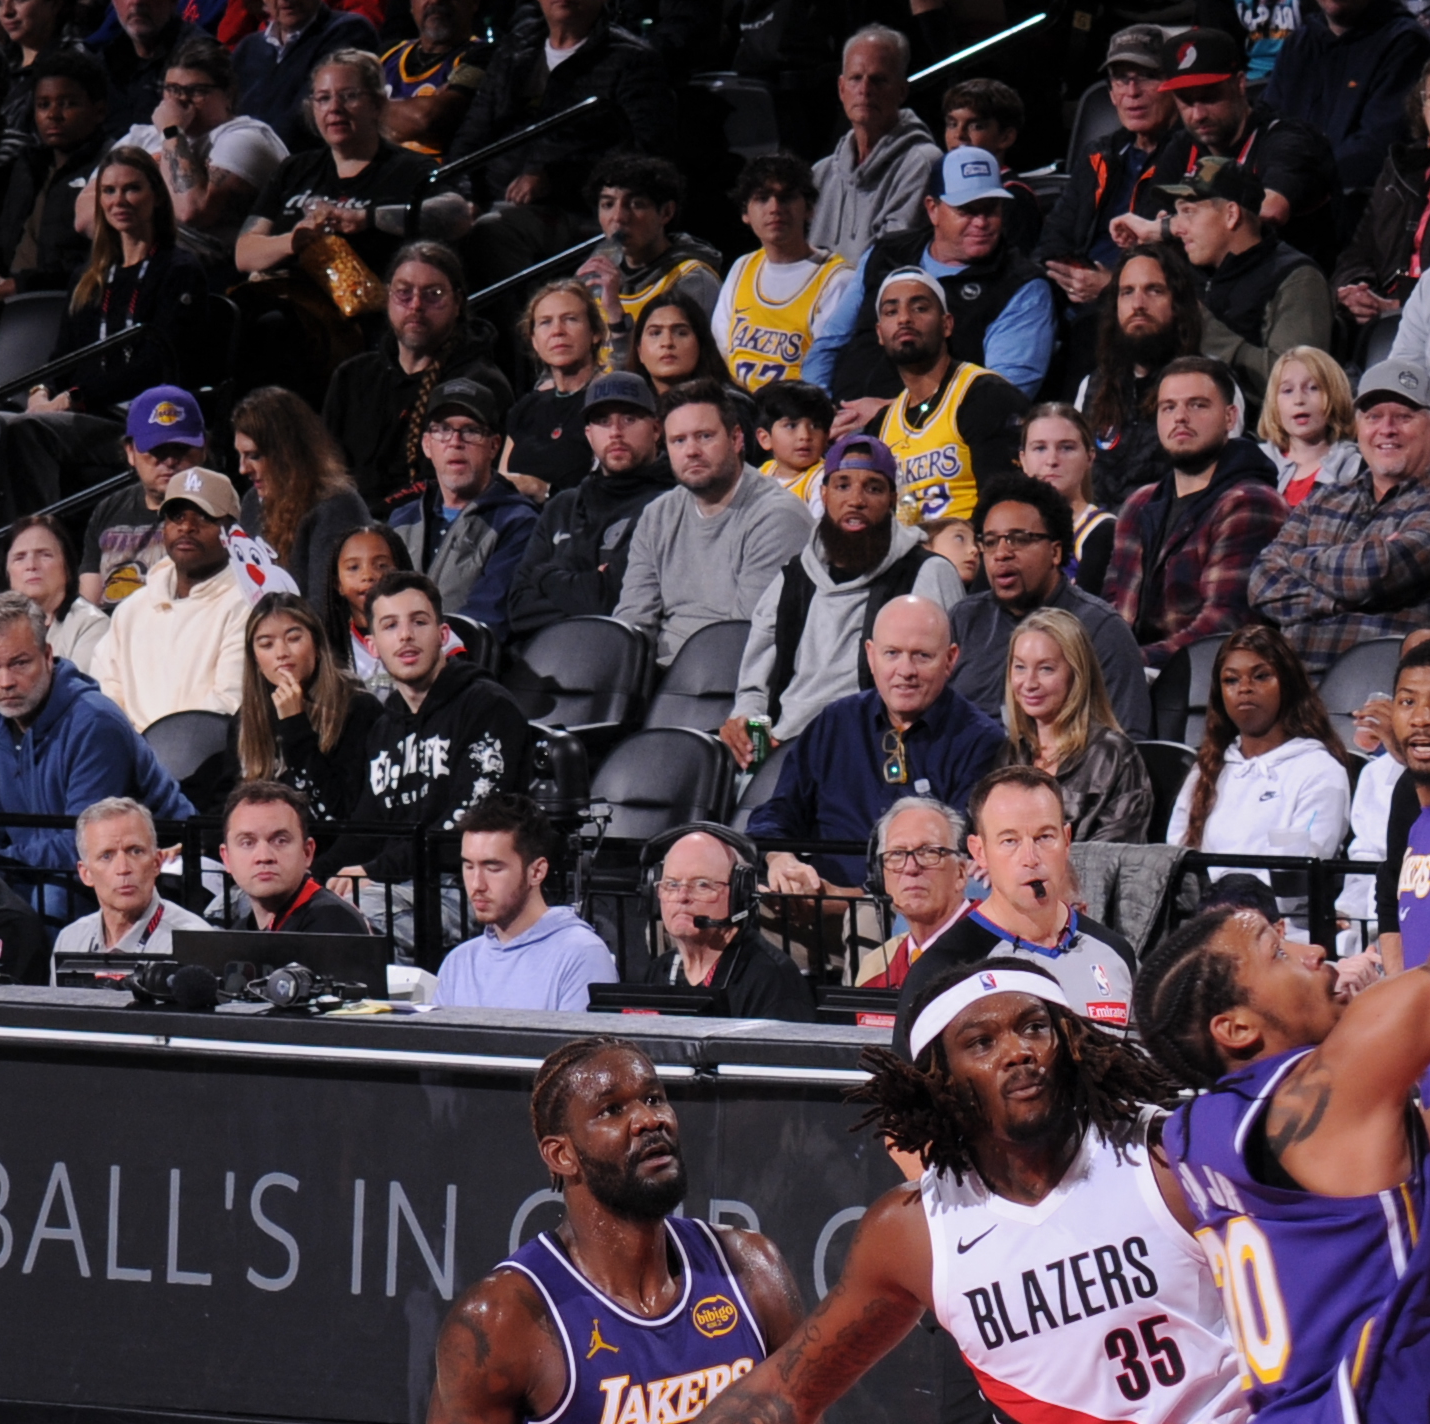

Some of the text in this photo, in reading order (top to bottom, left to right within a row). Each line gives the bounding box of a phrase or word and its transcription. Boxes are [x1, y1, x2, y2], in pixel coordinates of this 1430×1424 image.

[350, 1178, 458, 1302] IN
[695, 1306, 734, 1325] bibigo
[962, 1236, 1161, 1352] BLAZERS
[1103, 1313, 1187, 1402] 35
